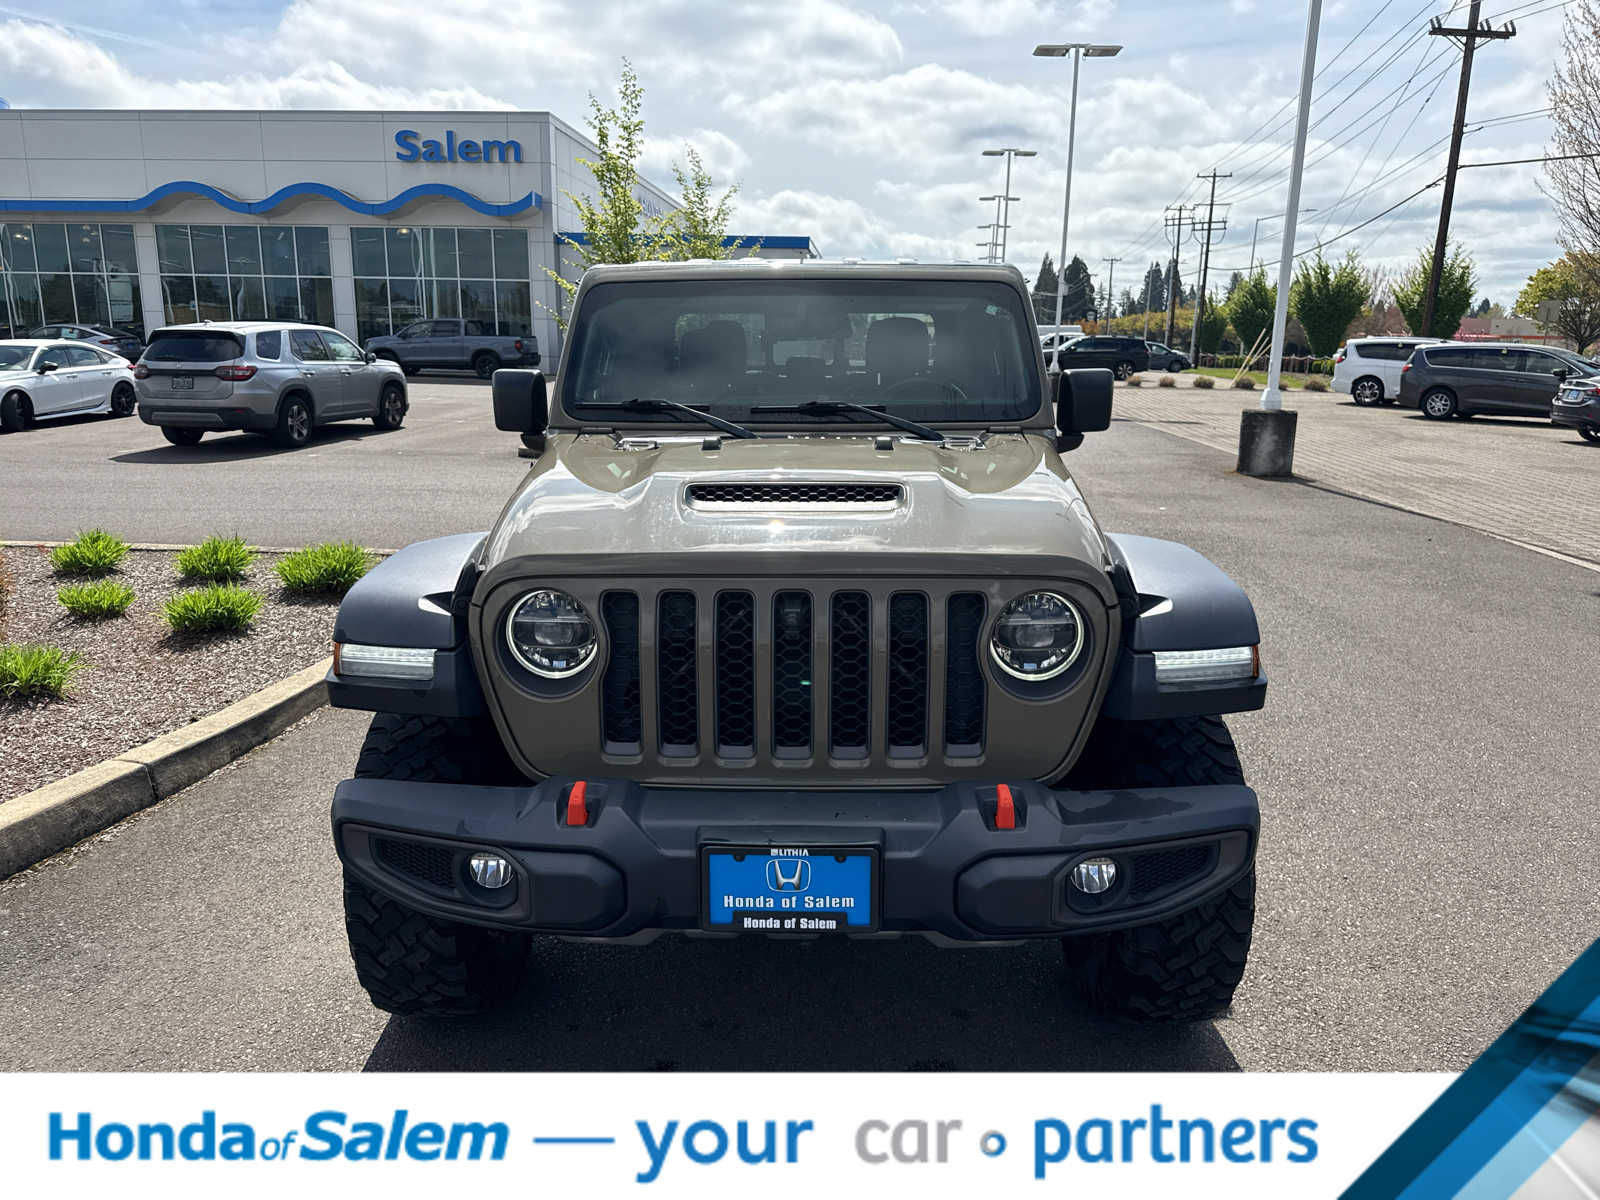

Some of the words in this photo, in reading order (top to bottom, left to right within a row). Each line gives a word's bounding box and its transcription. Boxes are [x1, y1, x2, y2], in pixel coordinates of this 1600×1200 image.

[394, 129, 522, 164] Salem
[778, 848, 809, 857] LITHIA
[723, 895, 774, 908] Honda
[781, 895, 796, 908] of
[804, 896, 855, 908] Salem
[743, 917, 780, 929] Honda
[784, 918, 796, 929] of
[800, 918, 837, 930] Salem
